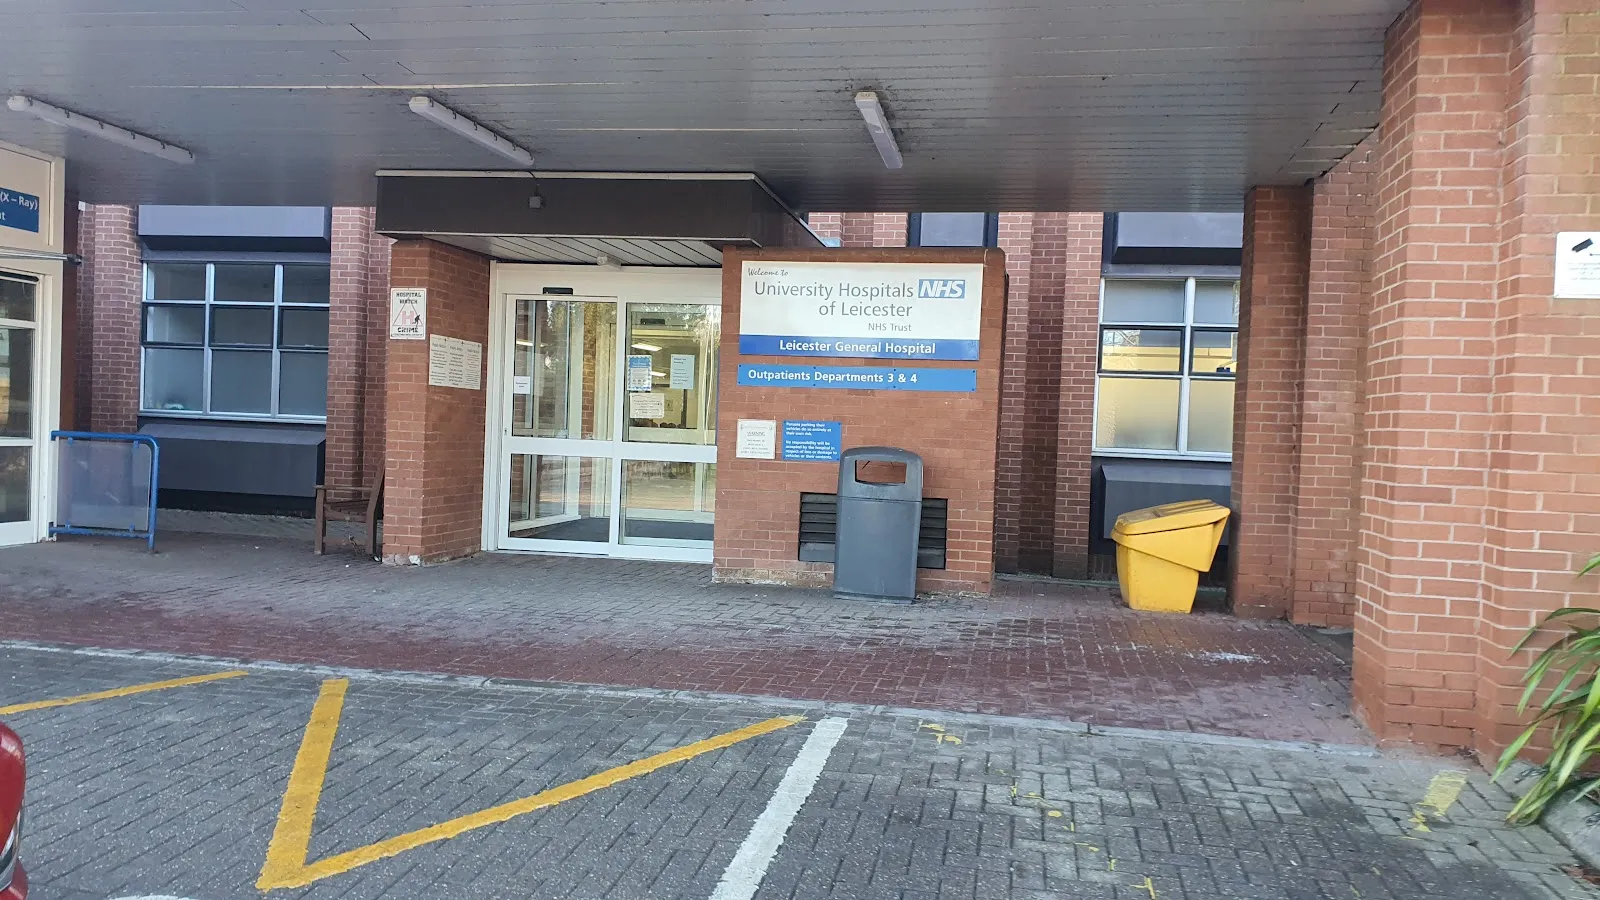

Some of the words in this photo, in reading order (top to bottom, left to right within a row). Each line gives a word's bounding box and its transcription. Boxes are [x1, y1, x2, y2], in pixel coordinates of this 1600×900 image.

[18, 196, 38, 210] Ray)
[748, 267, 779, 276] Welcome
[755, 281, 833, 300] University
[839, 282, 914, 300] Hospitals
[919, 280, 964, 298] NHS
[819, 301, 836, 316] of
[841, 301, 912, 317] Leicester
[868, 322, 887, 331] NHS
[890, 323, 912, 332] Trust
[779, 340, 831, 352] Leicester
[835, 341, 881, 353] General
[885, 342, 936, 355] Hospital
[748, 369, 811, 382] Outpatients
[814, 371, 883, 385] Departments
[887, 373, 894, 383] 3
[898, 374, 906, 383] &
[910, 374, 918, 383] 4
